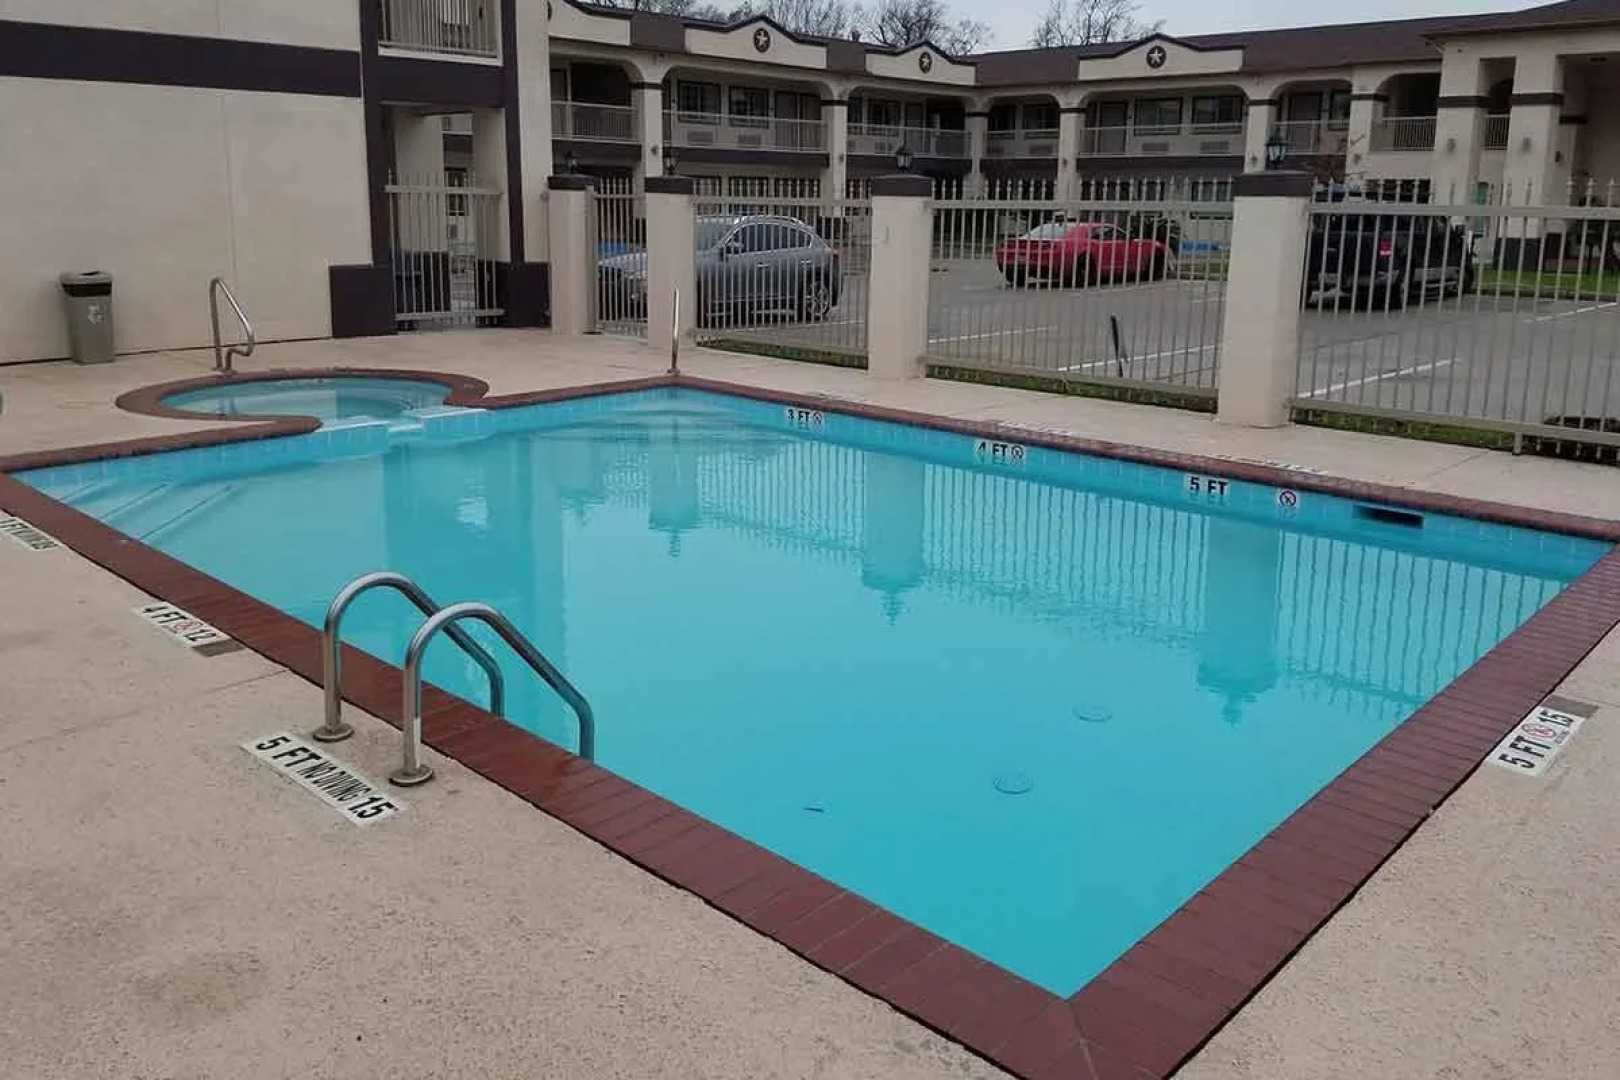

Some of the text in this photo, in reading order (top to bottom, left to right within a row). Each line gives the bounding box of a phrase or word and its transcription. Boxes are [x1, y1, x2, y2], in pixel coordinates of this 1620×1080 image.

[787, 408, 811, 423] 3 FT
[991, 443, 1008, 457] FT
[1190, 476, 1228, 497] 5 FT
[150, 611, 188, 624] FT
[256, 735, 292, 750] 5
[1509, 735, 1552, 757] FT
[271, 746, 322, 768] FT
[1498, 753, 1536, 769] 5
[312, 770, 372, 802] DIVING
